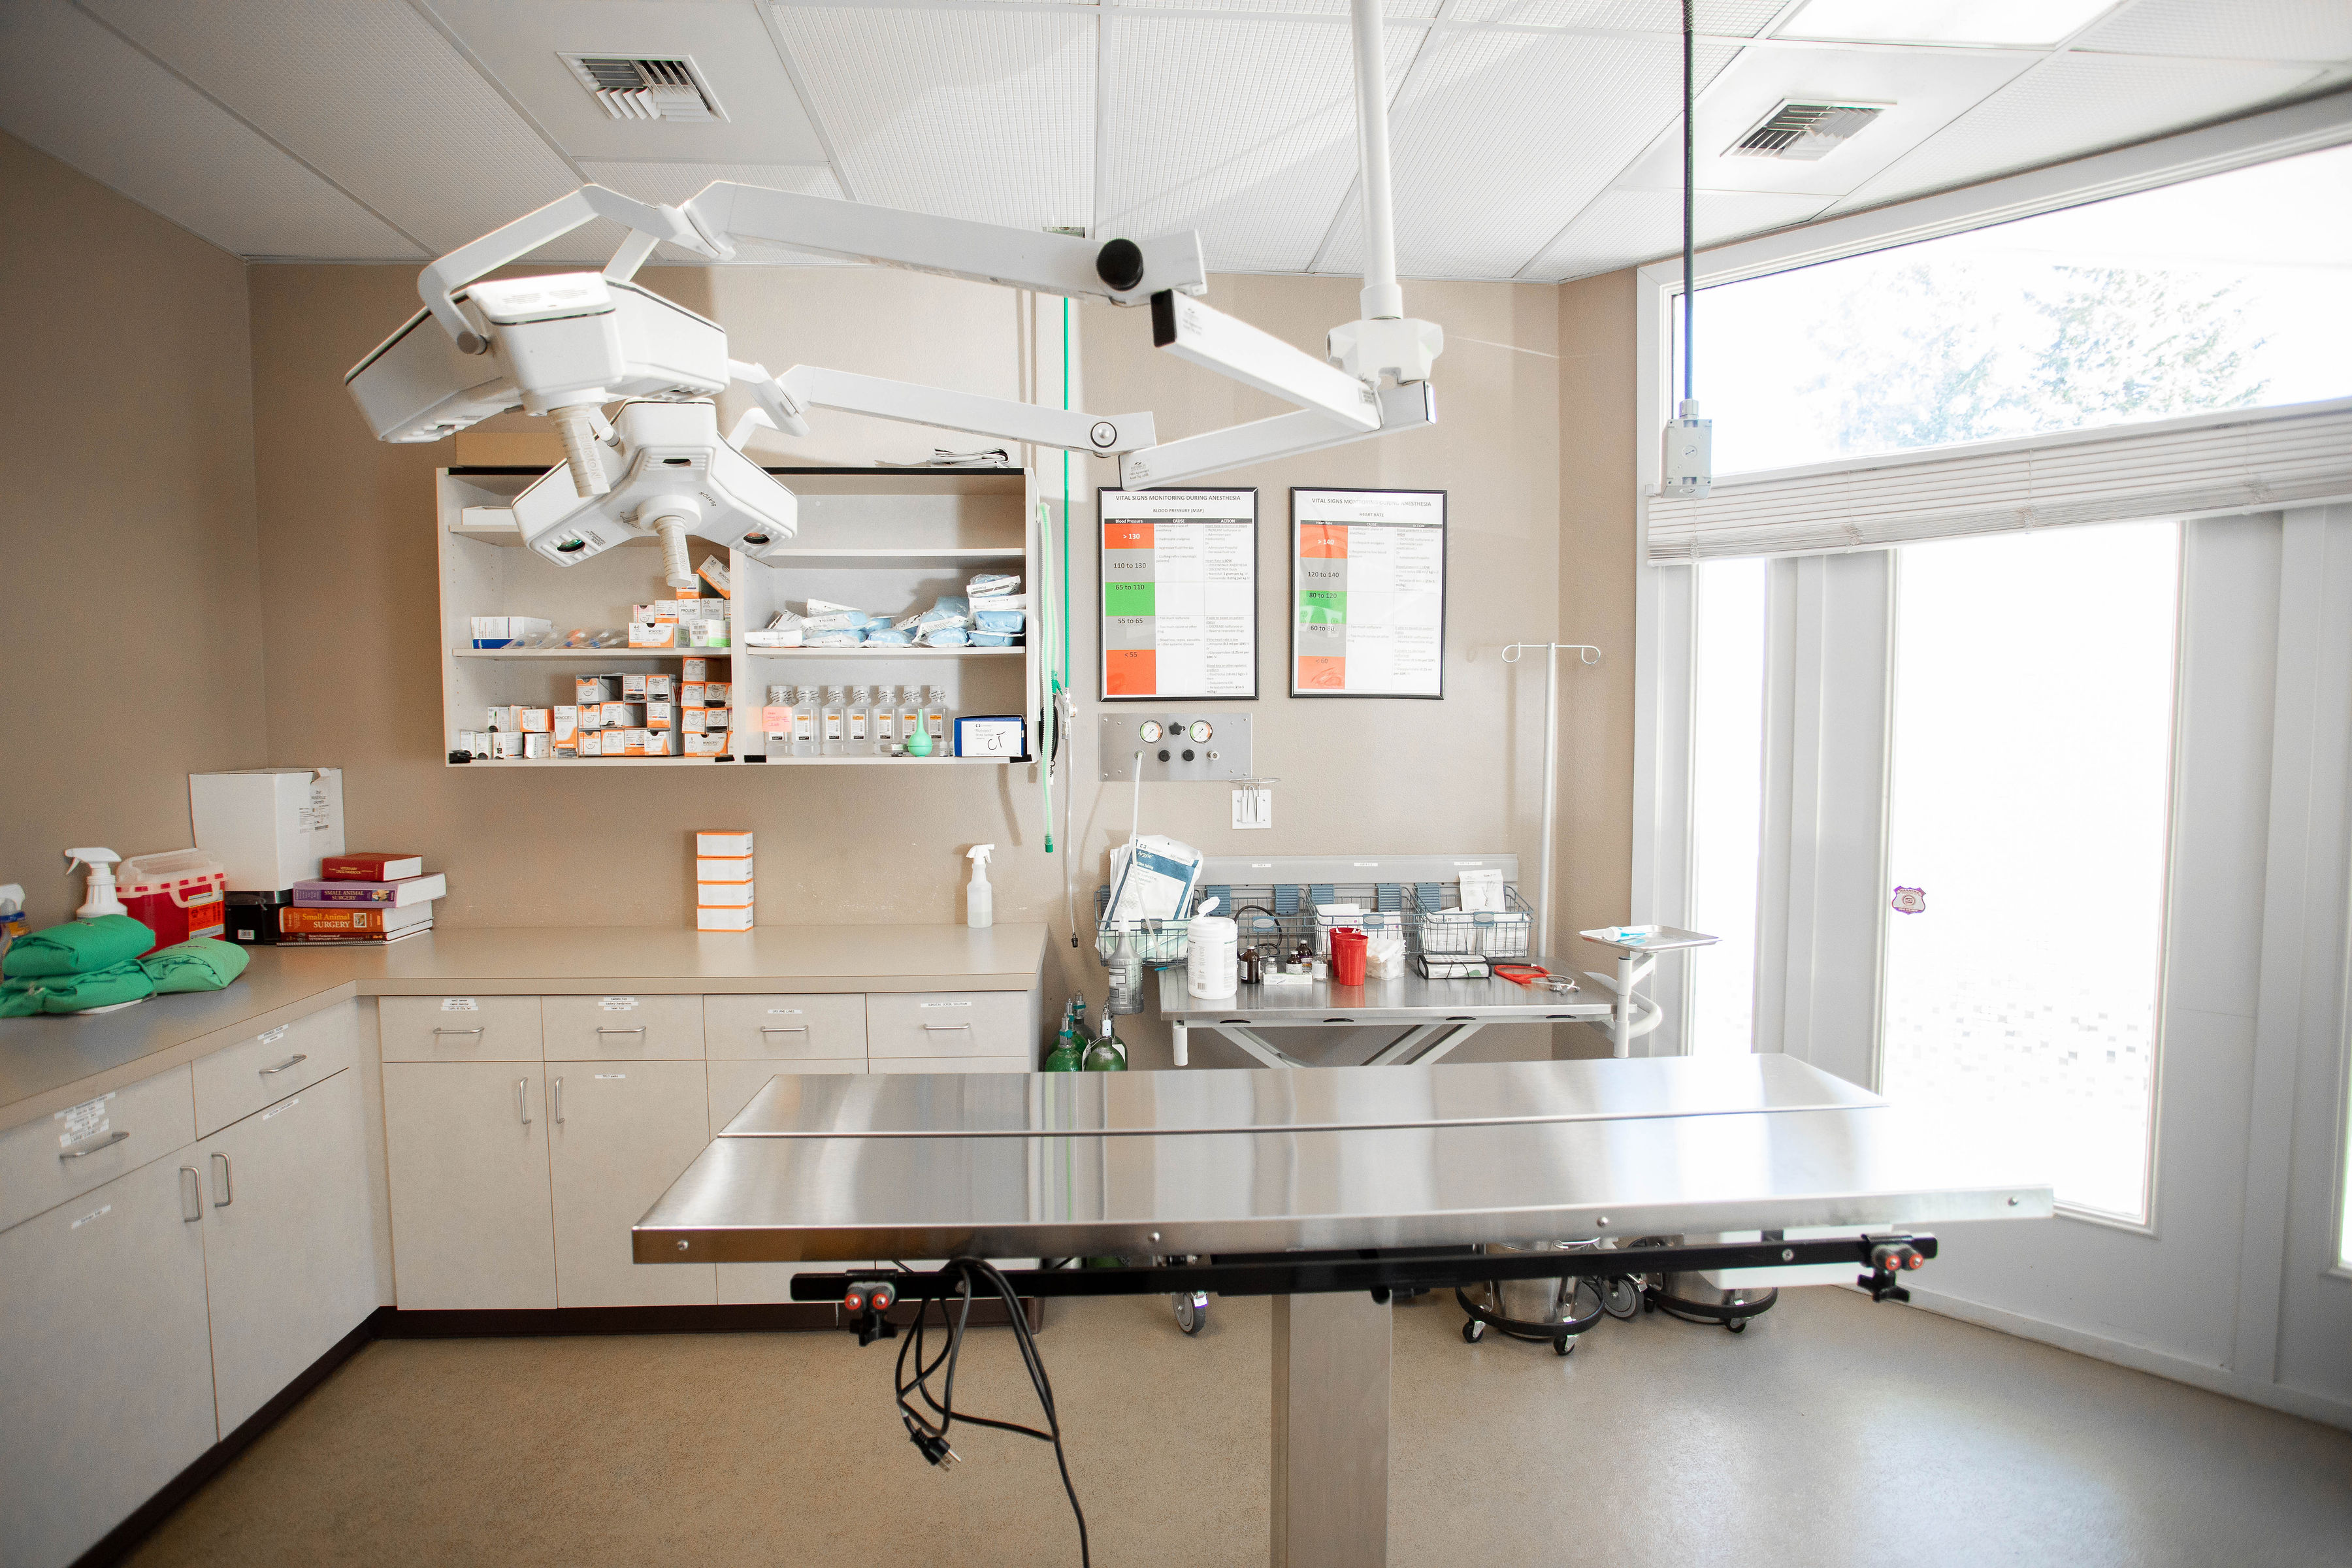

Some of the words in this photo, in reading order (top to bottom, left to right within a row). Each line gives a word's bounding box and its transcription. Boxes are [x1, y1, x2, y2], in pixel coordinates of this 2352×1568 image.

[579, 434, 601, 479] BURTON
[698, 492, 716, 507] BURTON
[675, 538, 688, 571] BURTON
[988, 731, 1006, 750] CT
[1138, 851, 1154, 859] Argyle
